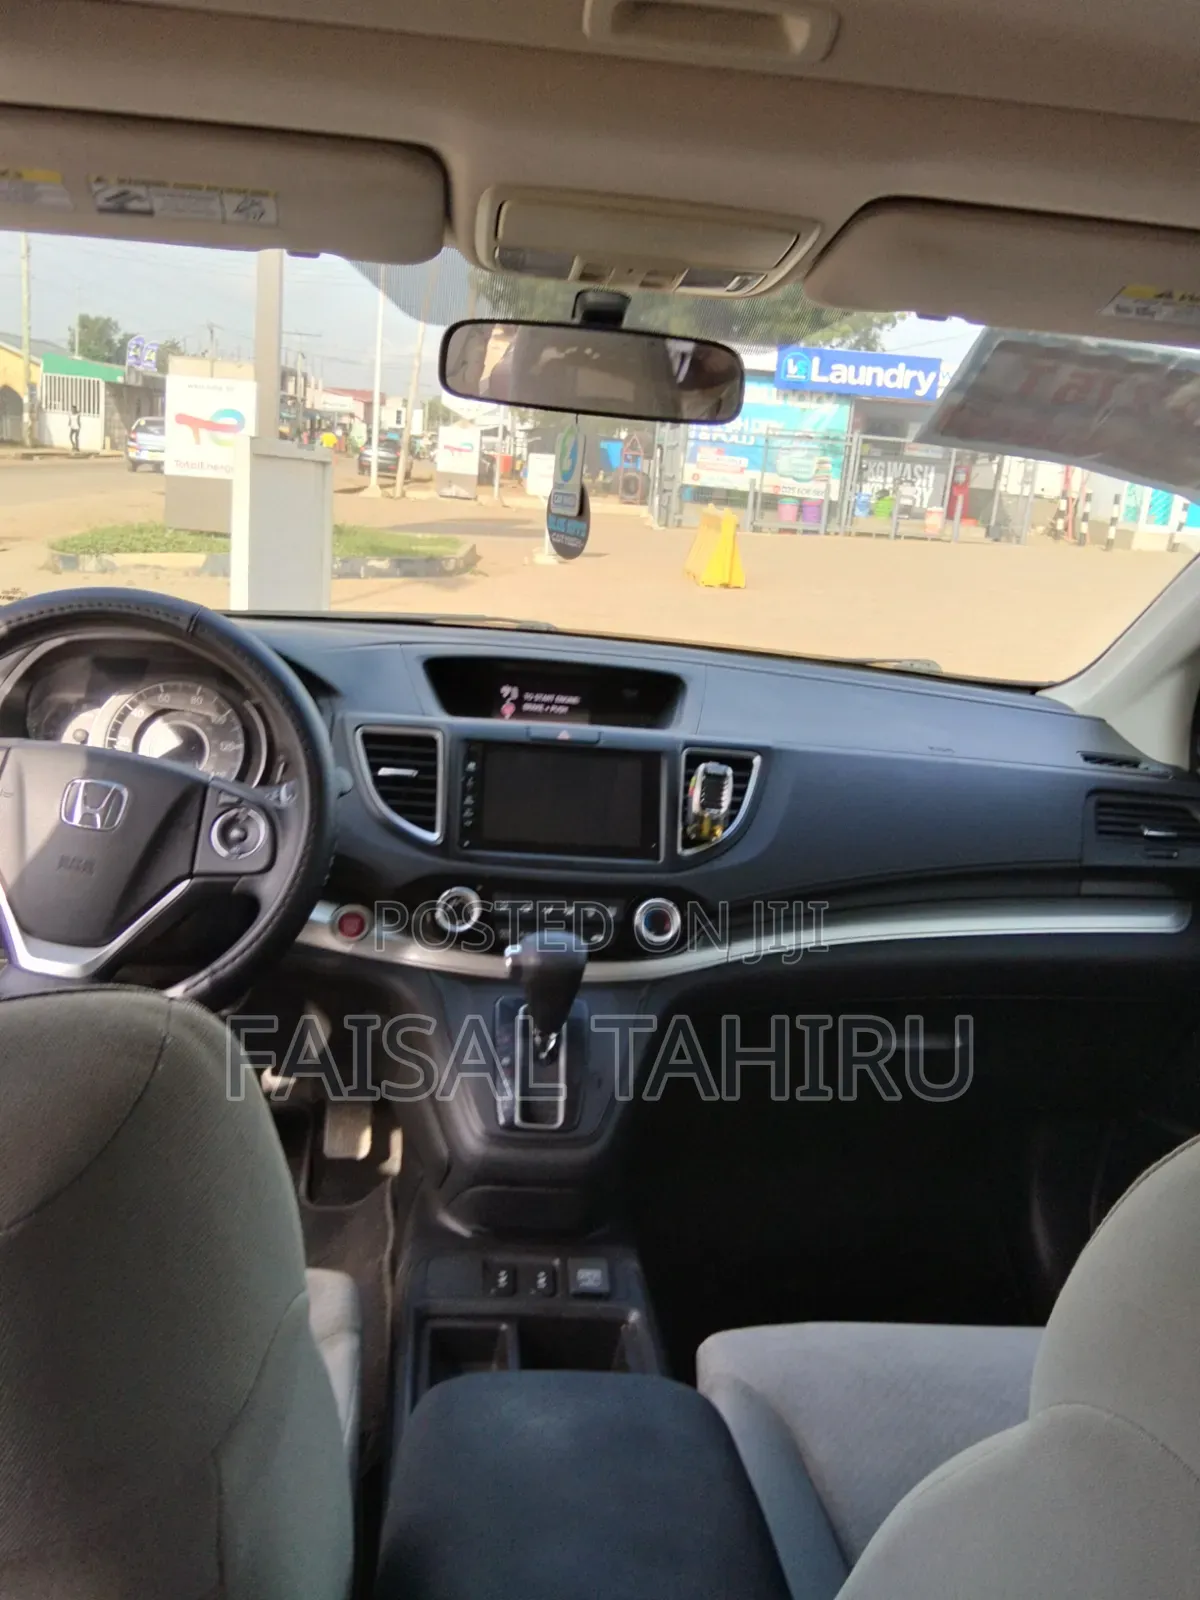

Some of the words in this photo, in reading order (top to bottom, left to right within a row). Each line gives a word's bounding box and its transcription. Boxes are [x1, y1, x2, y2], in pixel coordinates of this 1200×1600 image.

[810, 355, 936, 397] Laundry
[157, 694, 171, 704] 60
[190, 696, 203, 706] 80
[132, 708, 145, 718] 40
